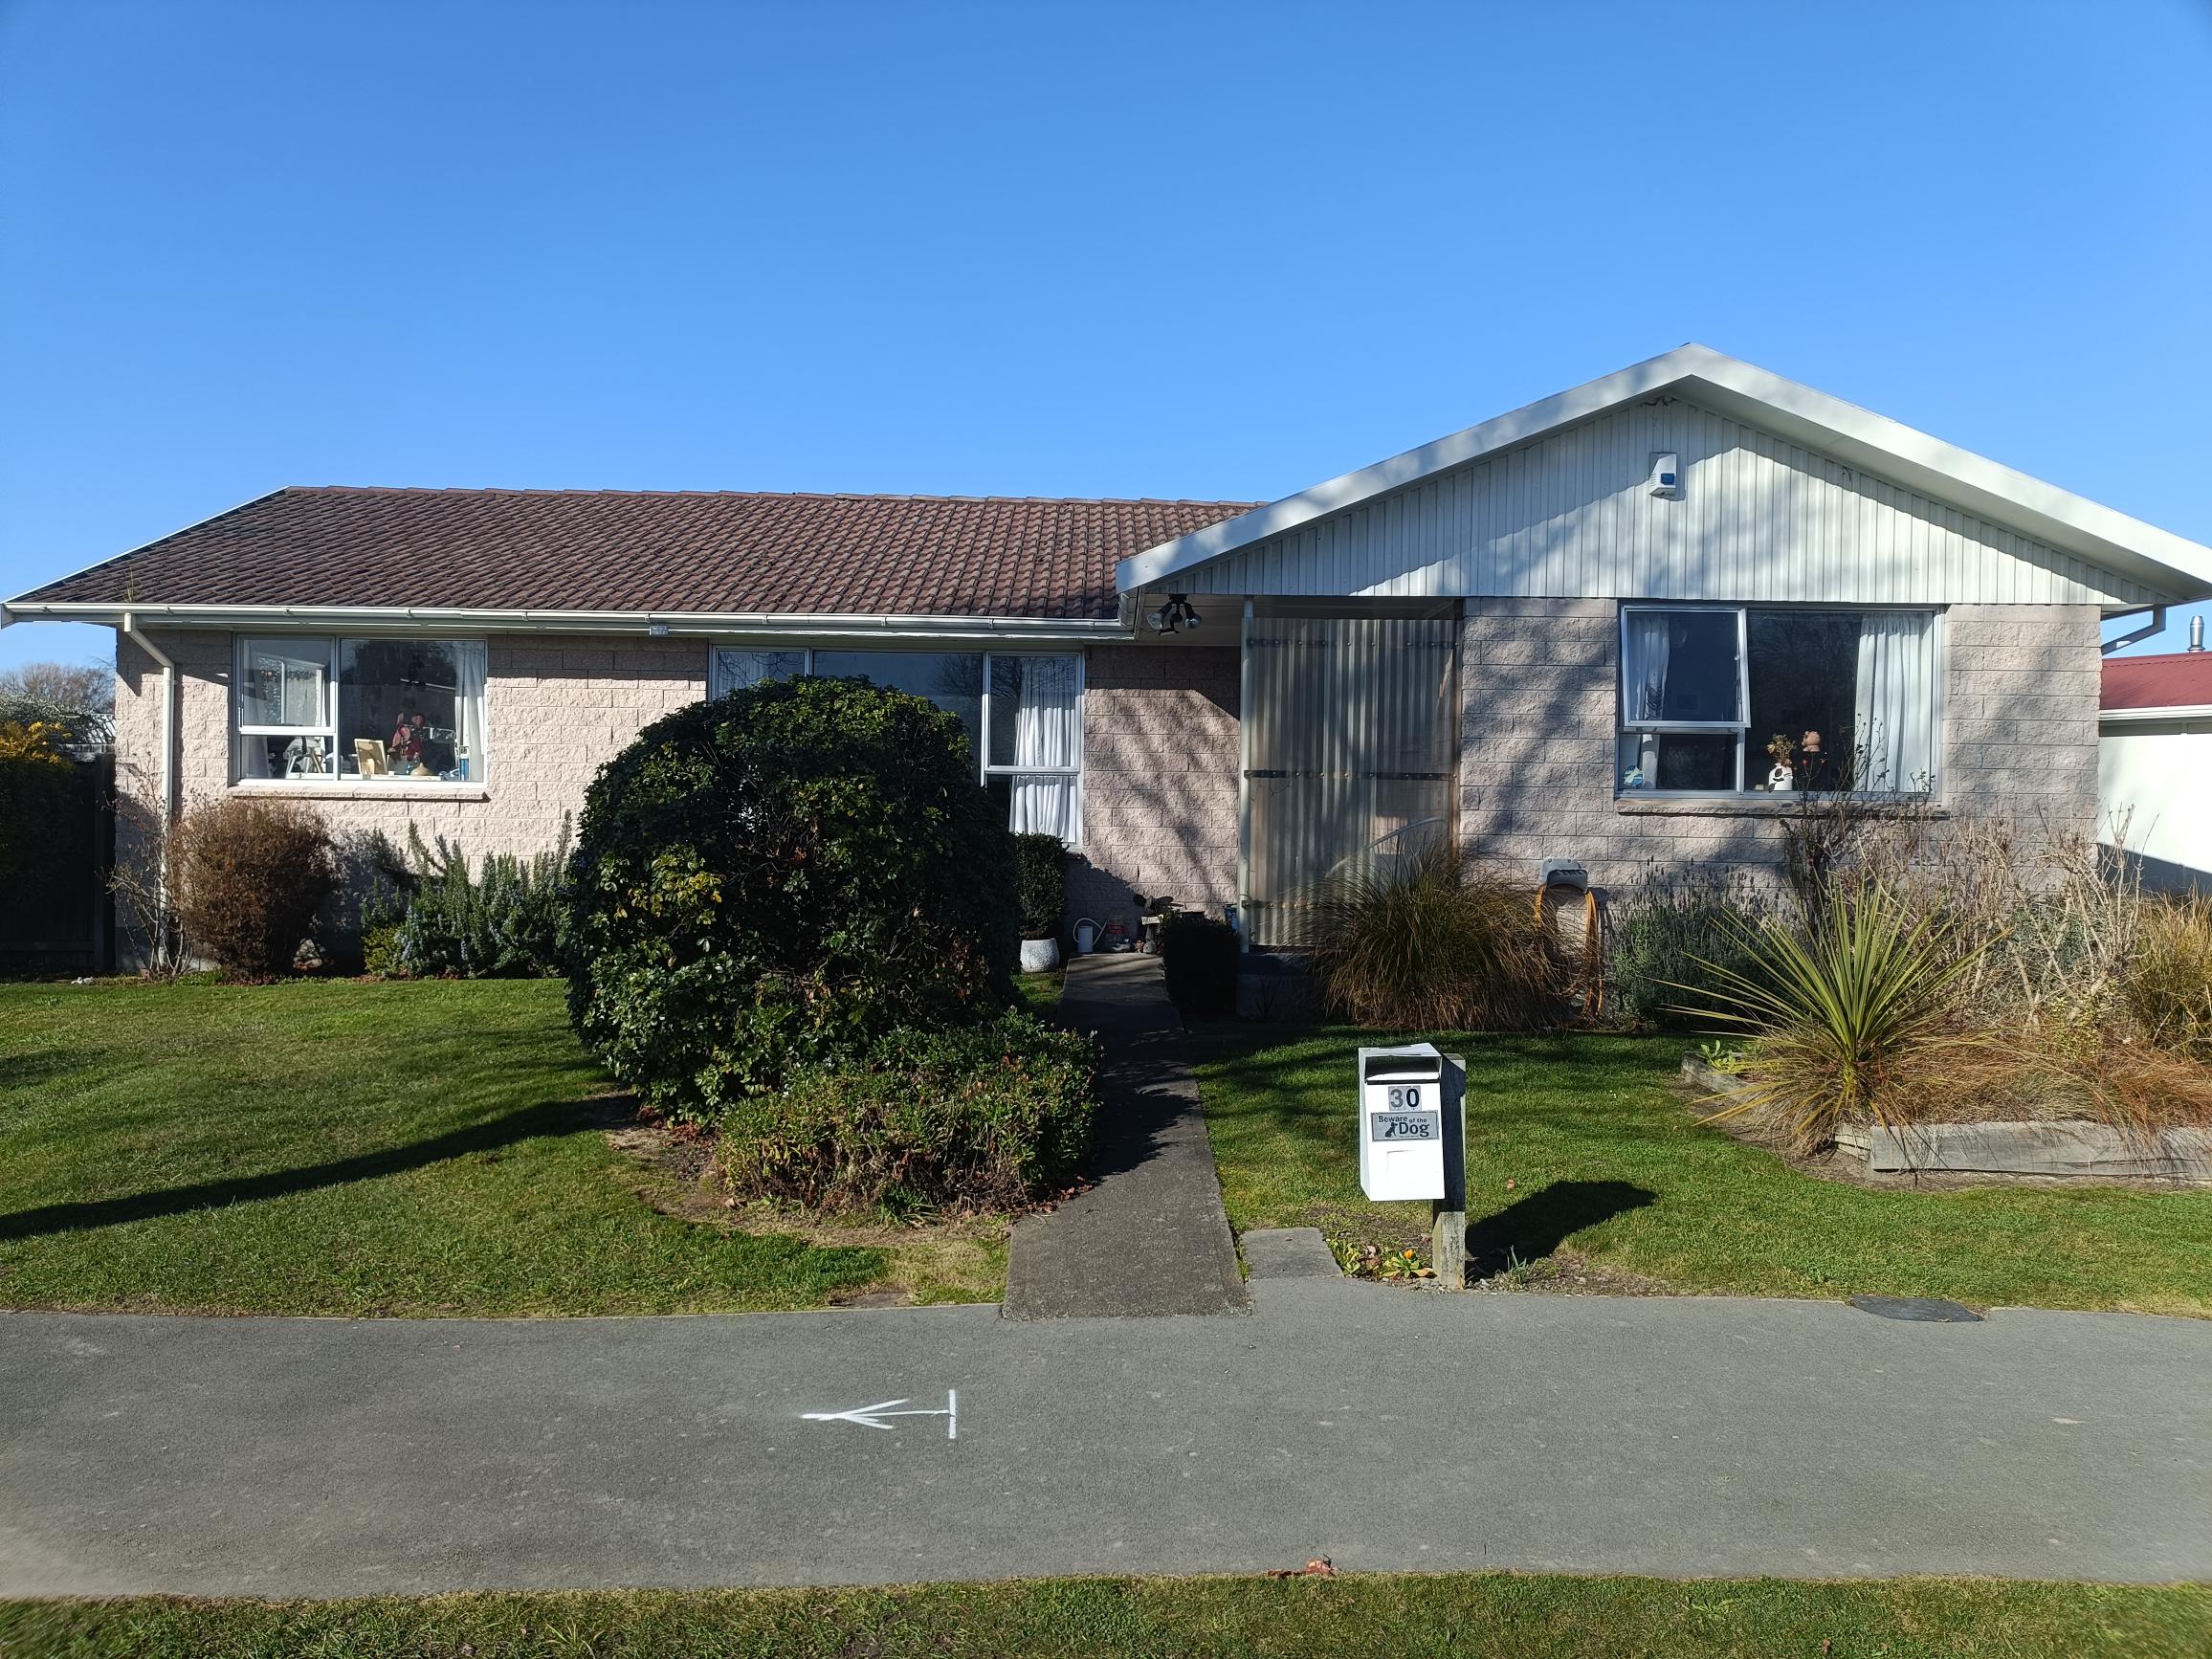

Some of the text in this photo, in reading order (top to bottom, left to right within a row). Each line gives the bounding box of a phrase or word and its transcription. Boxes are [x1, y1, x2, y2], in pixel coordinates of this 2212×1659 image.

[1390, 1088, 1419, 1108] 30
[1378, 1115, 1407, 1123] Beware
[1399, 1122, 1429, 1138] Dog
